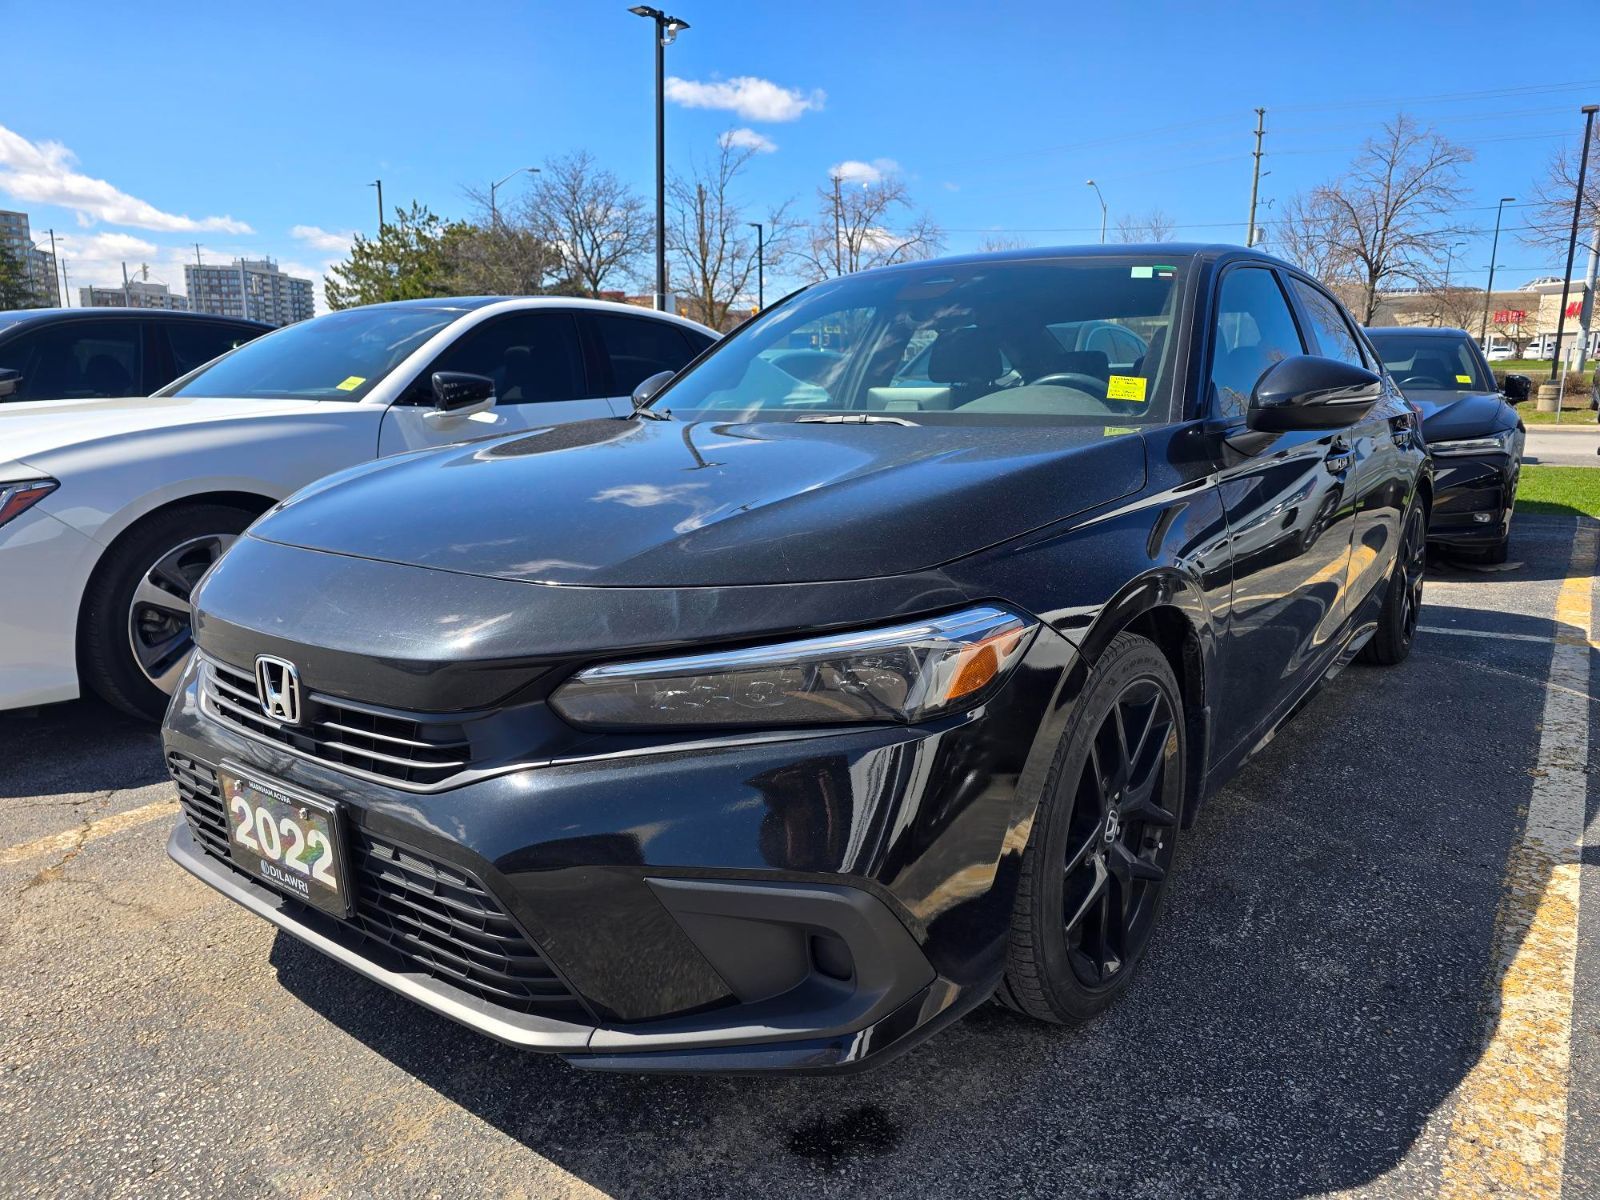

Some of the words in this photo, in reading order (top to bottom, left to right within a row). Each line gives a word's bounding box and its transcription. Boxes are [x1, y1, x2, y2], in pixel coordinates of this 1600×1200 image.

[273, 791, 292, 805] ACURA
[230, 795, 338, 890] 2022
[269, 864, 310, 894] DILAWRI
